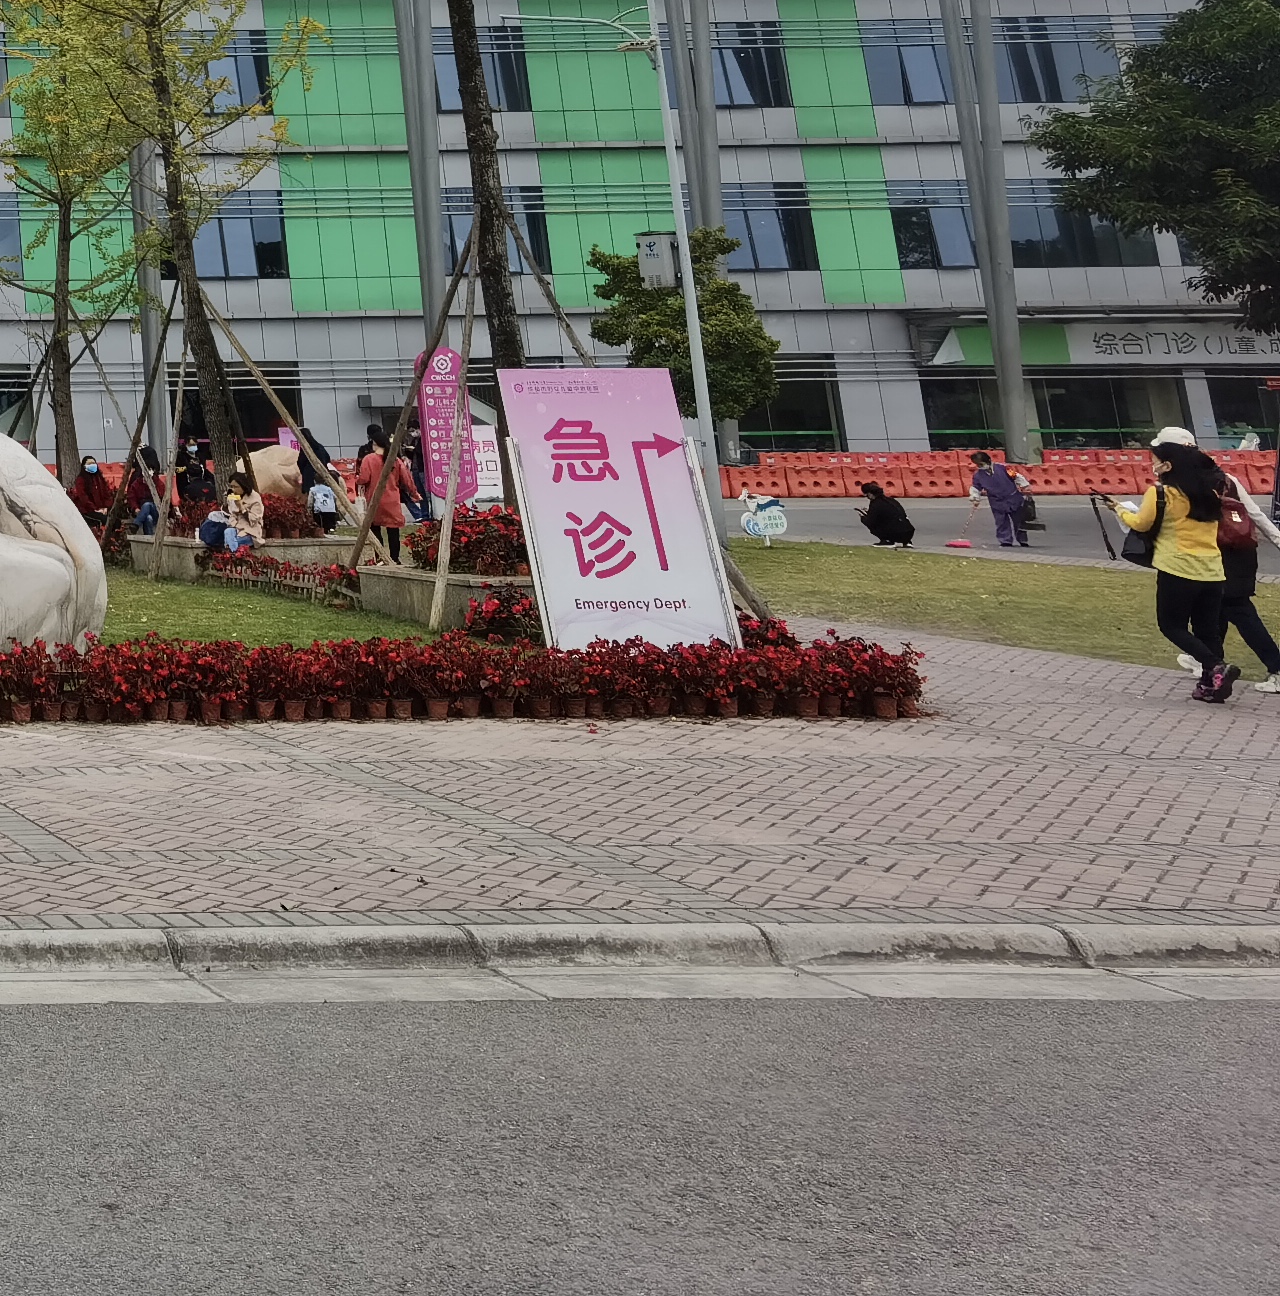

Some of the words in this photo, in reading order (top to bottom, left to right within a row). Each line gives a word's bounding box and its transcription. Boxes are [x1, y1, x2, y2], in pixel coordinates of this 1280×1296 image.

[543, 417, 637, 579] 急诊
[574, 598, 650, 612] Emergency
[653, 598, 691, 612] Dept.
